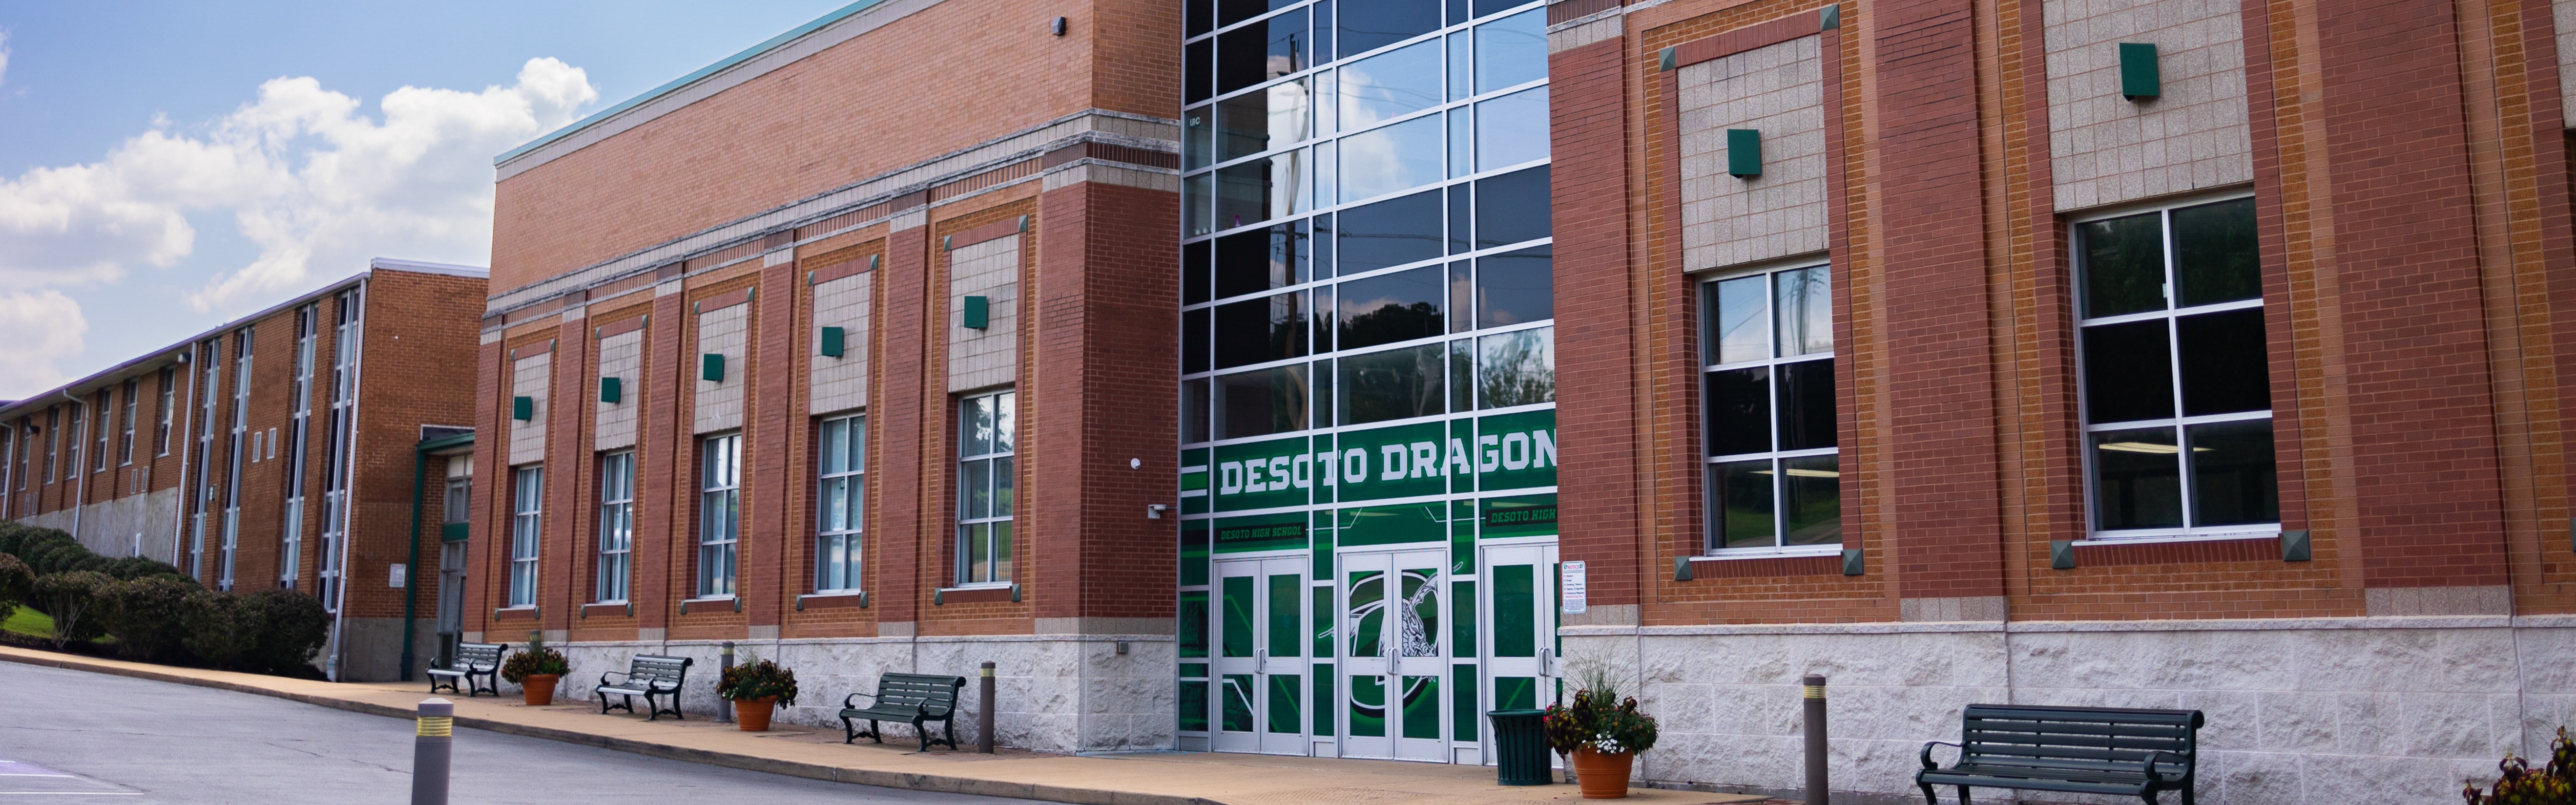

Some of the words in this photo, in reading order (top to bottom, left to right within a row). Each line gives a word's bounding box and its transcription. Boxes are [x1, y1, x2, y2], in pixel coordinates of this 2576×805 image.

[1190, 117, 1200, 126] LRC
[1221, 447, 1367, 495] DESOTO
[1381, 428, 1557, 481] DRAGON
[1491, 510, 1529, 523] DESOTO
[1531, 508, 1556, 520] HIGH
[1221, 529, 1250, 540] DESOTO
[1251, 528, 1270, 538] HIGH
[1272, 526, 1302, 537] SCHOOL
